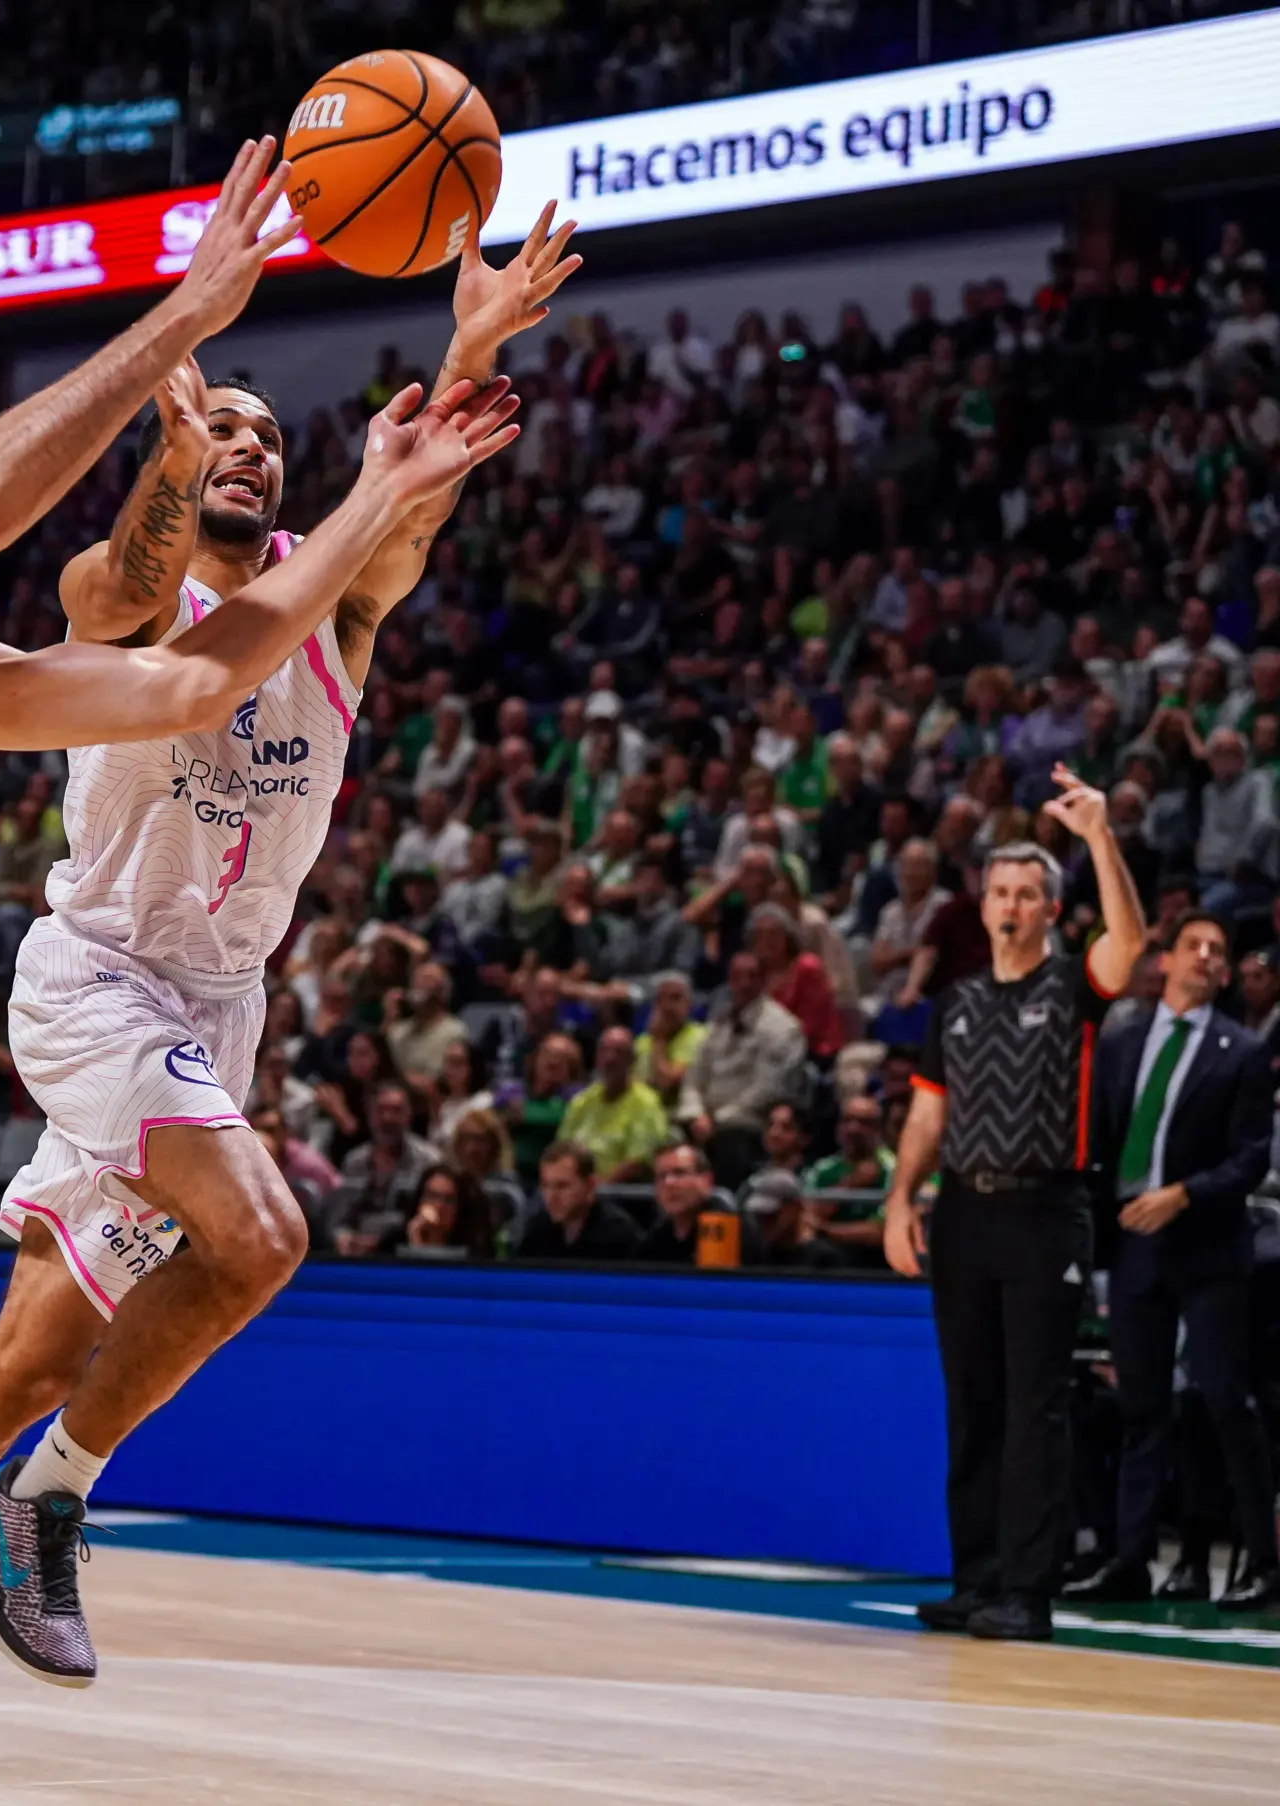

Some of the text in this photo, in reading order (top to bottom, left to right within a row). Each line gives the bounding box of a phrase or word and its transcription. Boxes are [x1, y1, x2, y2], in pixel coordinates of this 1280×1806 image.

[567, 80, 1053, 199] Hacemos equipo
[101, 1224, 135, 1258] del
